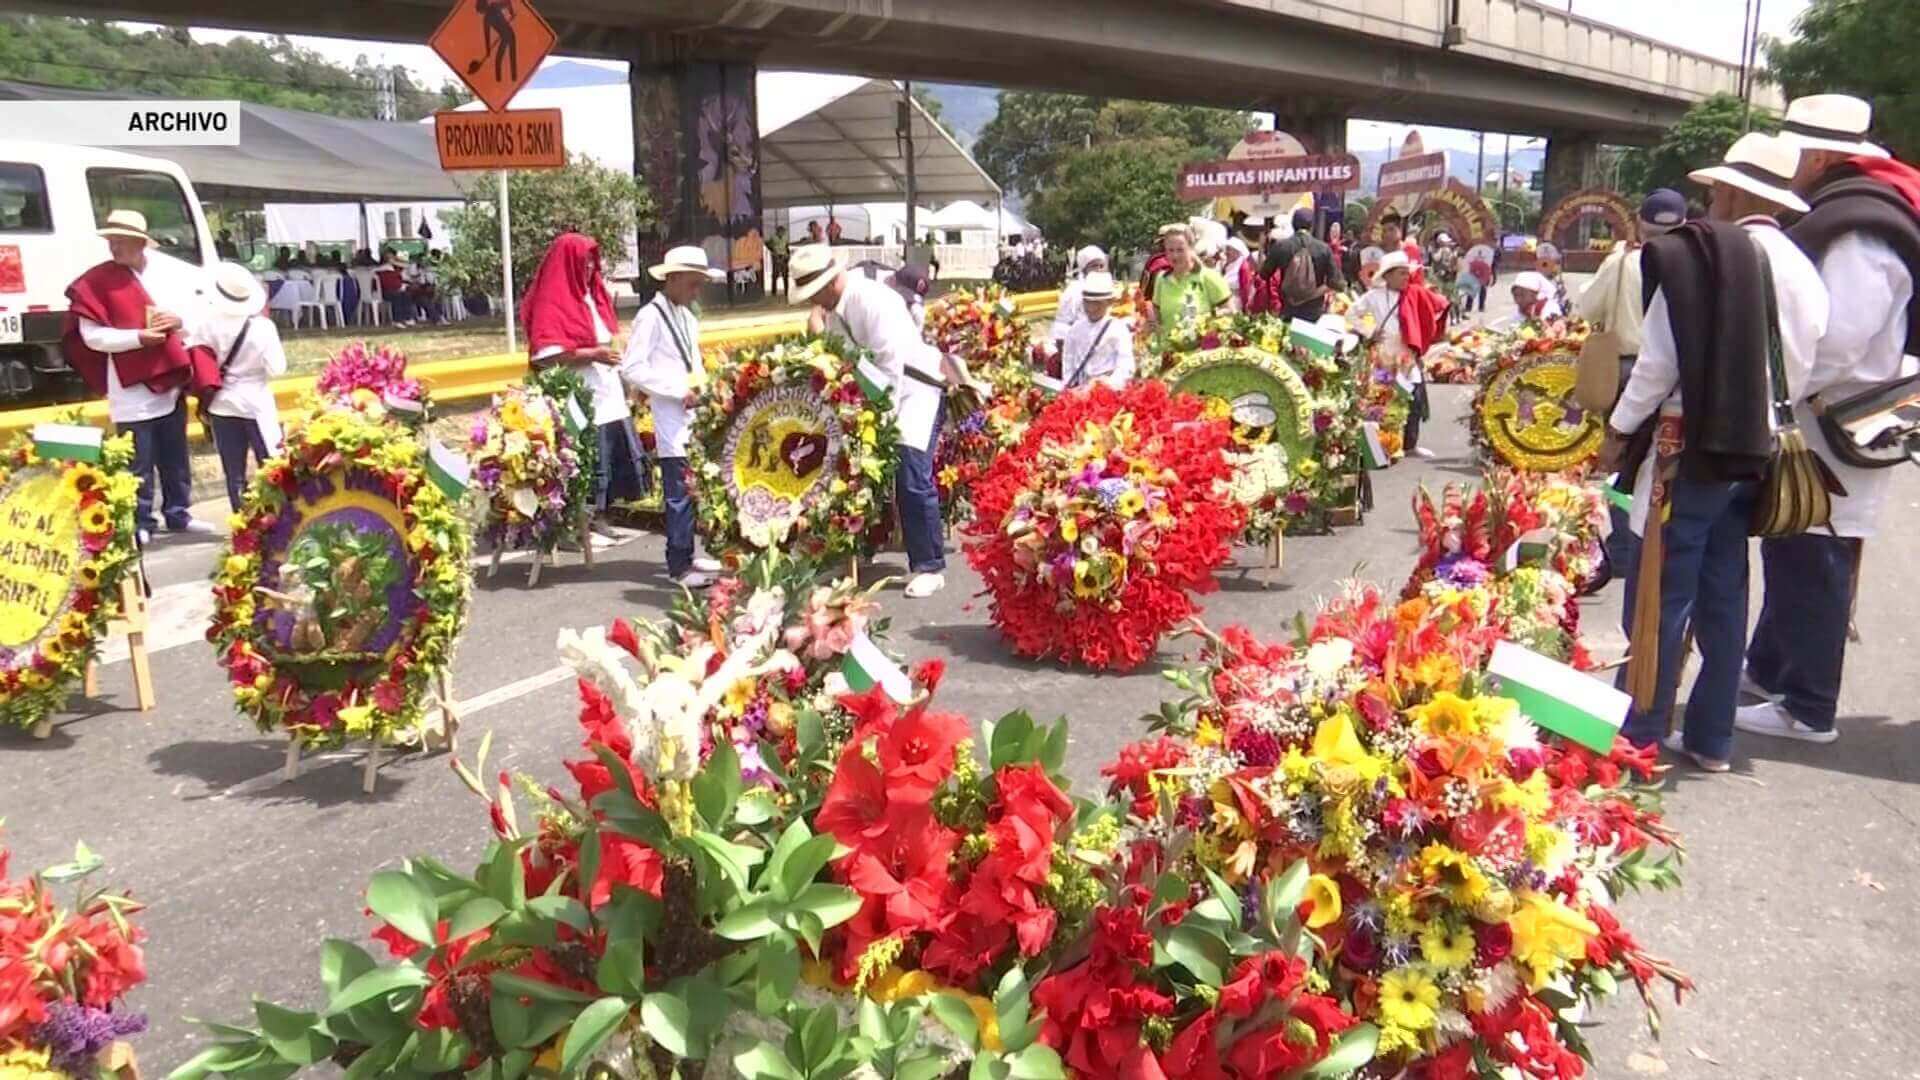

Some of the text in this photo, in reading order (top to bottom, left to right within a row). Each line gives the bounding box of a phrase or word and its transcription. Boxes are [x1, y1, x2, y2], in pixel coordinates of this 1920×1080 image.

[517, 121, 555, 155] 1.5KM
[1186, 165, 1352, 187] SILLETAS INFANTILES
[9, 507, 55, 535] NO AL
[0, 541, 69, 576] ALTRATO
